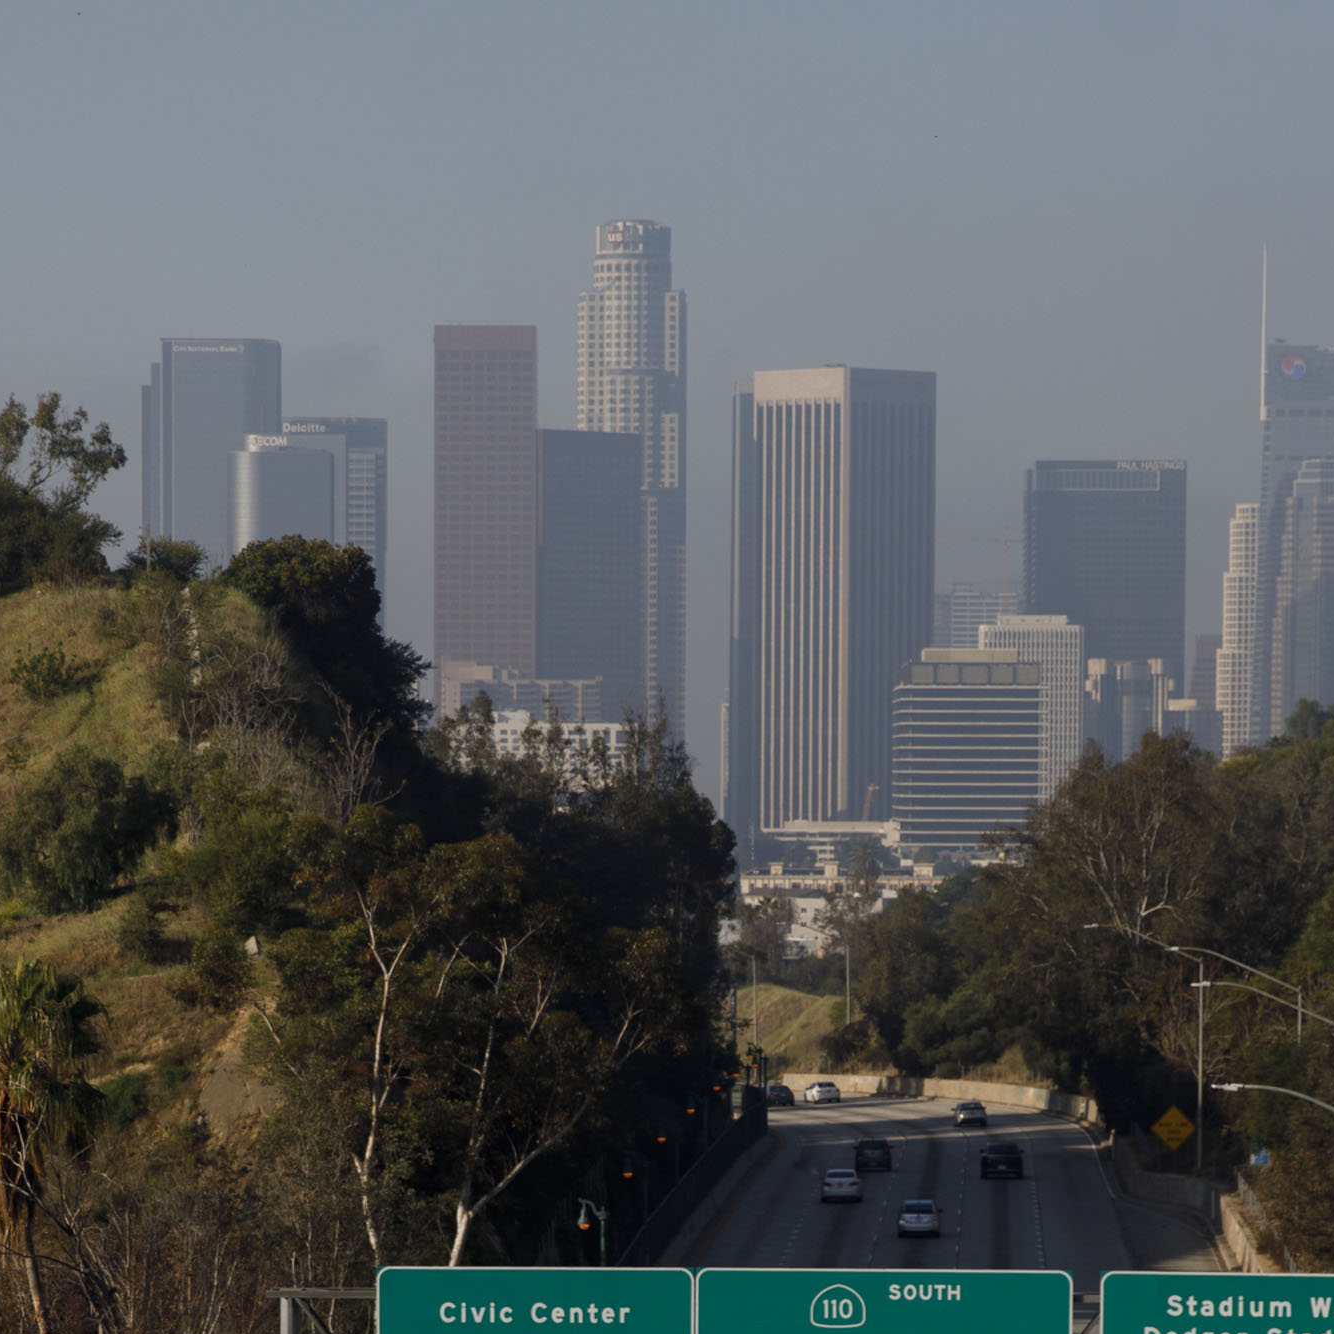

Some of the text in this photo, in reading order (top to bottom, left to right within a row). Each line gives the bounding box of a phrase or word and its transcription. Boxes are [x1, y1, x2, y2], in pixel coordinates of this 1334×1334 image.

[282, 423, 326, 432] Deloitte
[888, 1283, 961, 1302] SOUTH
[439, 1301, 631, 1324] Civic Center
[822, 1298, 854, 1320] 110
[1166, 1294, 1292, 1317] Stadium
